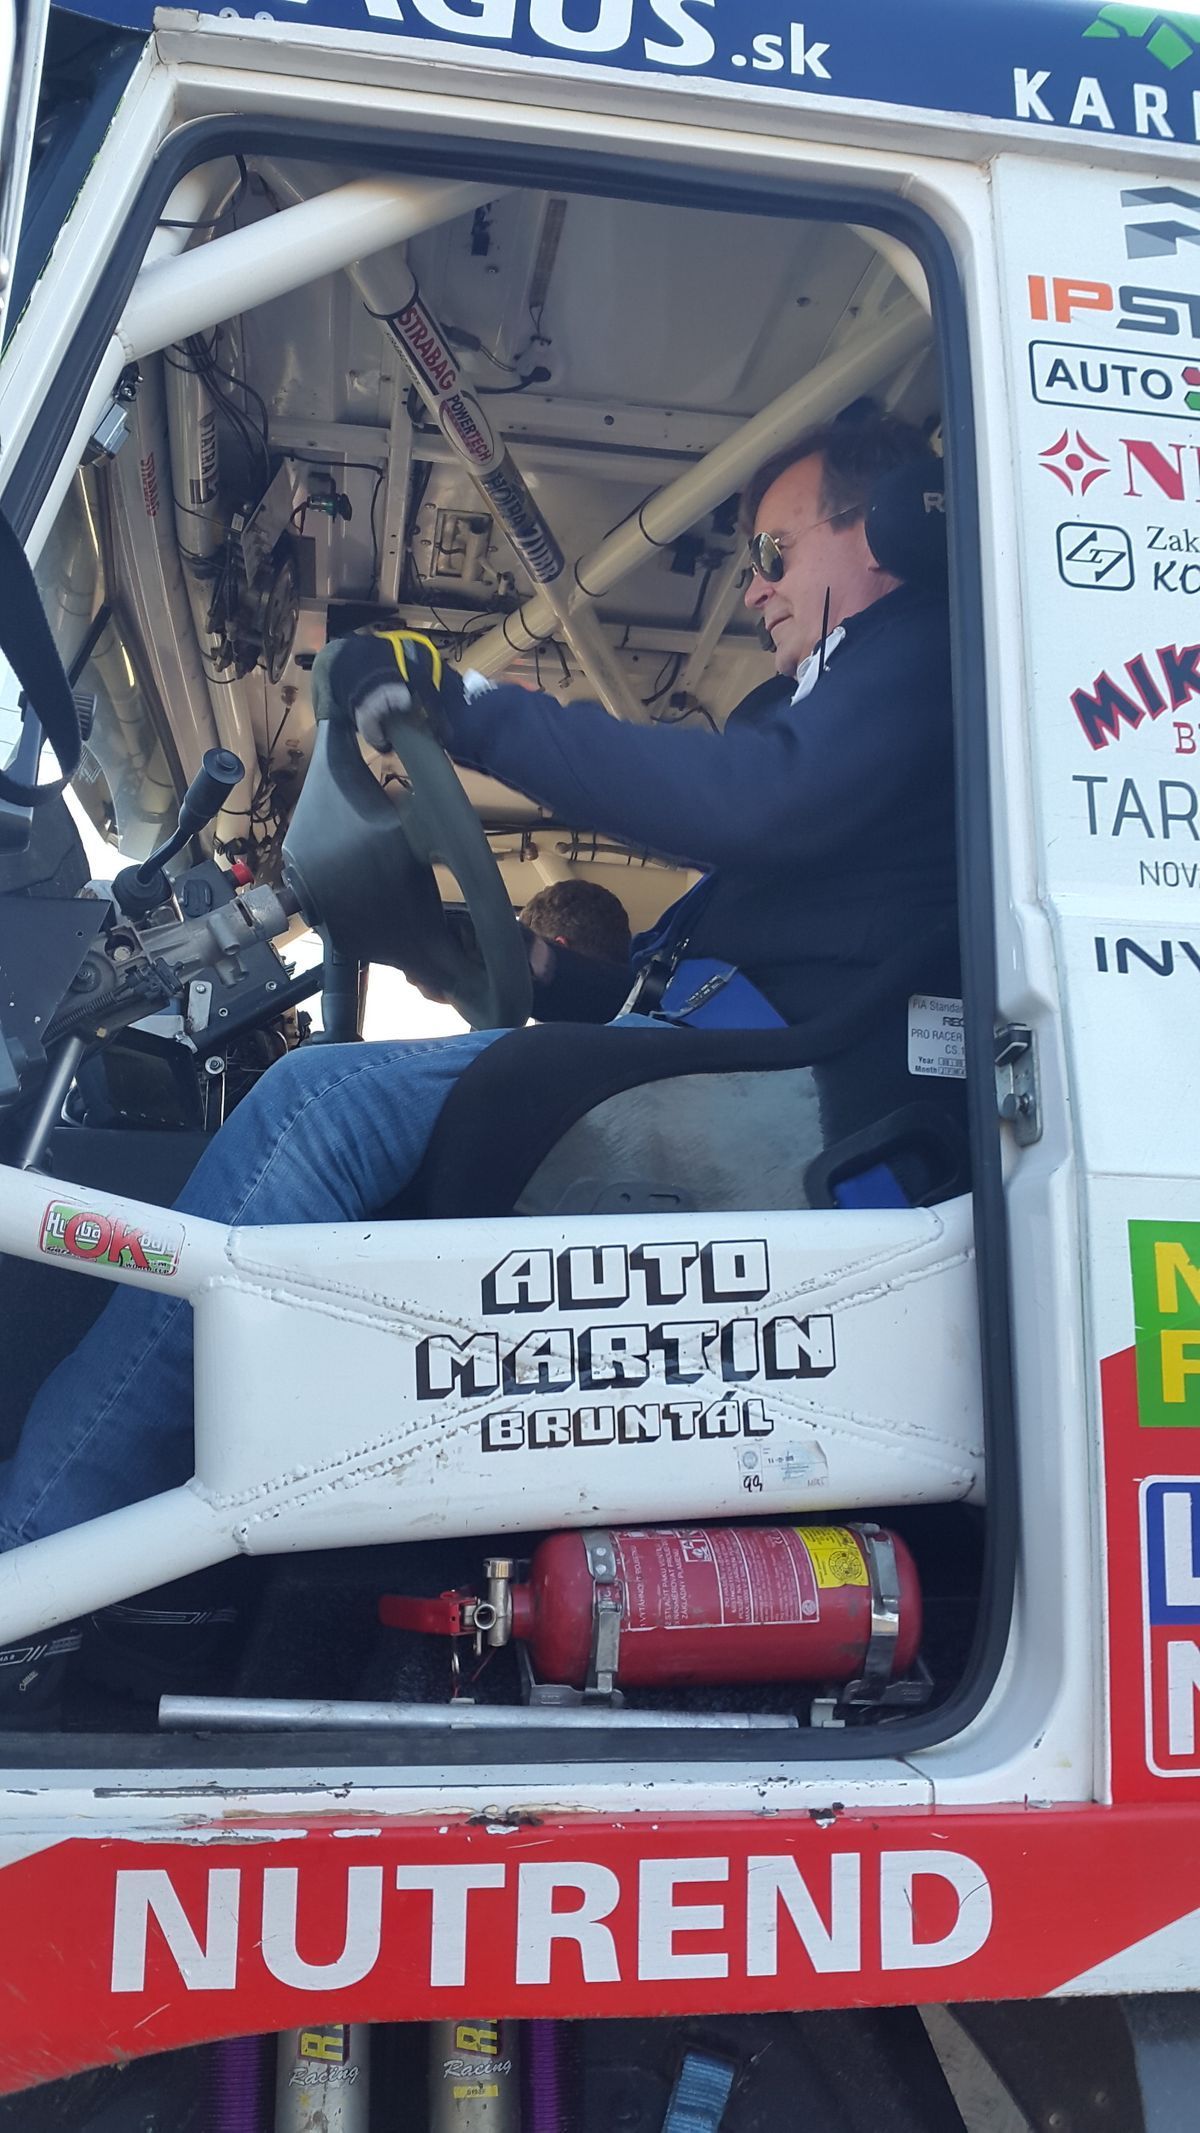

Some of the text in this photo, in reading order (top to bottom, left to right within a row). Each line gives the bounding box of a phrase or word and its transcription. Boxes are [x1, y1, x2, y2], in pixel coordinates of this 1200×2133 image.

[1013, 68, 1200, 141] KAR
[397, 306, 456, 391] STRABAG
[1045, 358, 1173, 401] AUTO
[447, 395, 492, 464] POWERTECH
[1119, 438, 1200, 503] N
[1139, 861, 1200, 889] NOV
[911, 1028, 962, 1042] PRO RACER
[929, 1000, 963, 1013] Standa
[64, 1211, 149, 1269] OK
[481, 1239, 770, 1315] AUTO
[416, 1314, 836, 1400] MARTIN
[481, 1390, 774, 1452] BRUNTÁL
[110, 1848, 993, 1995] NUTREND
[288, 2064, 361, 2087] Racing
[443, 2058, 513, 2079] Racing
